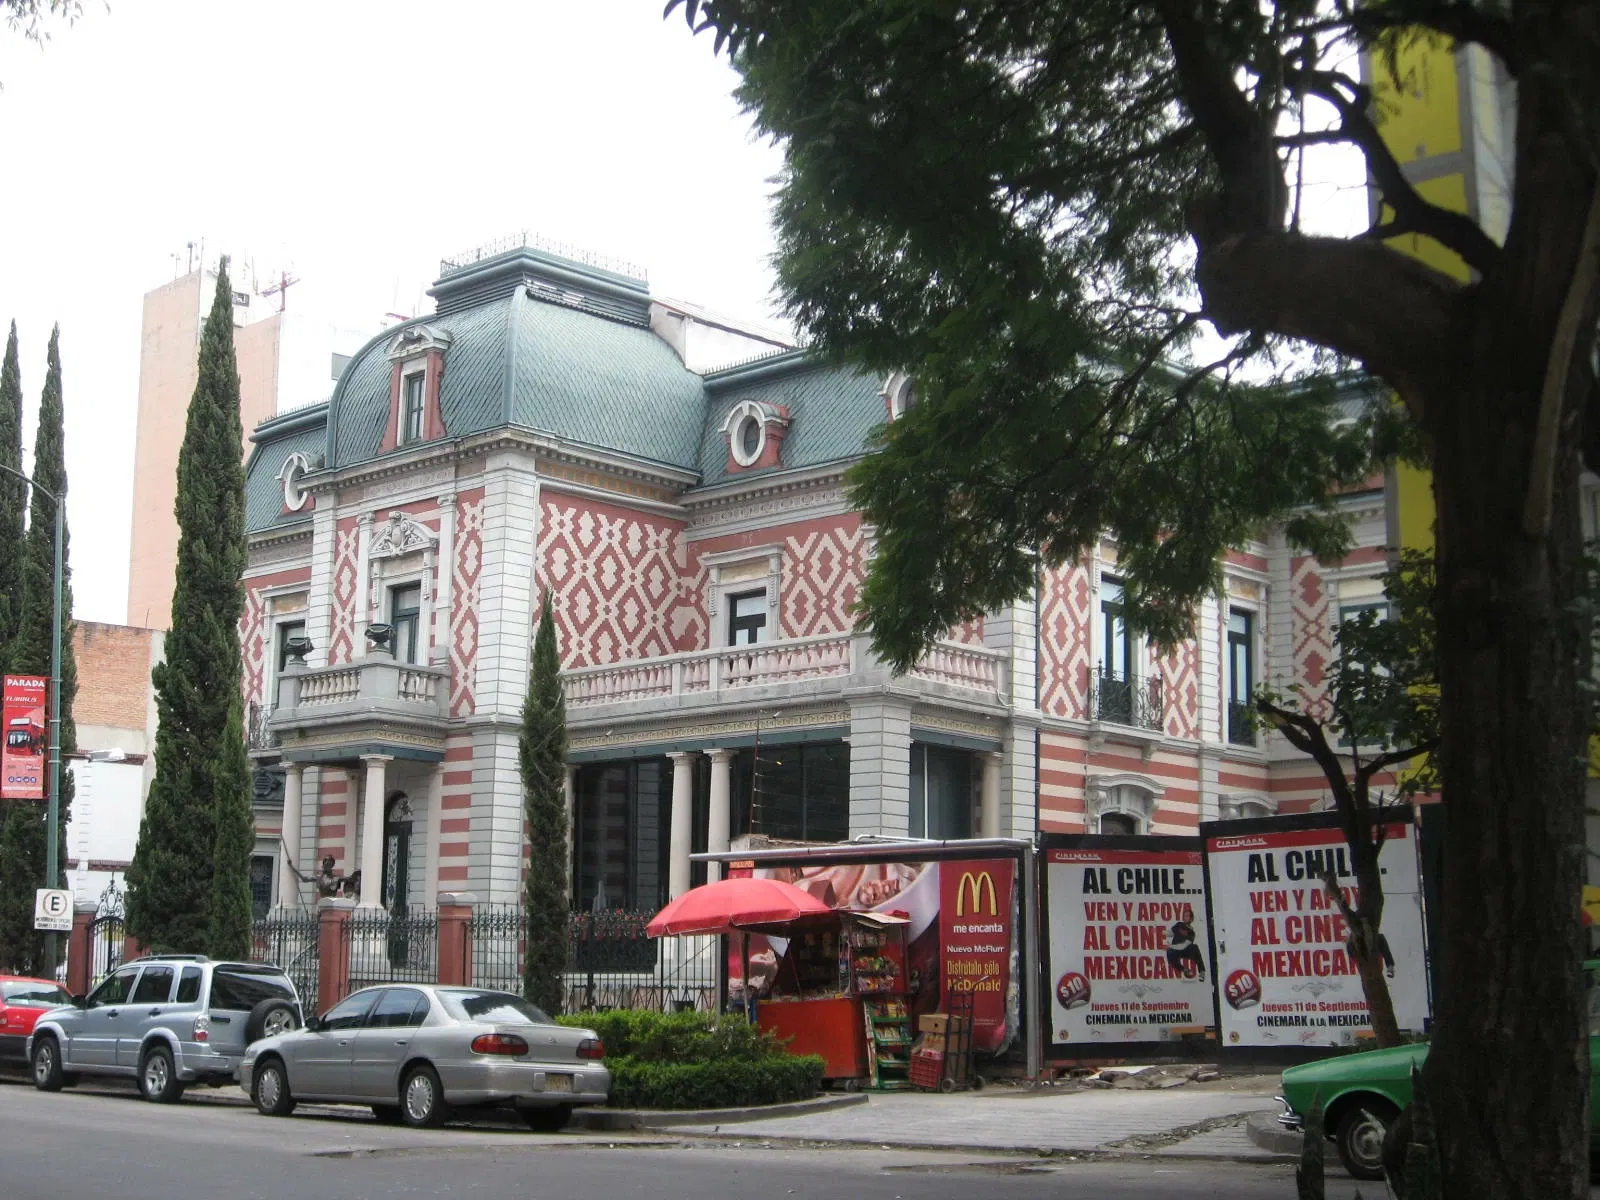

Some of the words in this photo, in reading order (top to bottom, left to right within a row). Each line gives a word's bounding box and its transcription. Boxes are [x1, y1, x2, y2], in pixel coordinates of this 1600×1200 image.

[7, 678, 45, 687] PARADA
[1248, 852, 1279, 883] AL
[1083, 867, 1111, 894] AL
[1118, 867, 1202, 894] CHILE...
[51, 896, 60, 911] E
[1250, 890, 1288, 913] VEN
[1293, 887, 1304, 911] Y
[1084, 902, 1118, 921] VEN
[1122, 902, 1133, 921] Y
[953, 925, 967, 933] me
[969, 924, 1003, 933] encanta
[1251, 917, 1280, 945] AL
[1285, 914, 1347, 944] CINE
[1084, 926, 1110, 950] AL
[1115, 925, 1168, 950] CINE
[947, 945, 972, 953] Nuevo
[1091, 1003, 1119, 1012] Jueves
[1121, 1002, 1129, 1012] 11
[1130, 1002, 1140, 1011] de
[1141, 1001, 1190, 1013] Septiembre
[1262, 1001, 1293, 1013] Jueves
[1296, 1001, 1304, 1012] 11
[1305, 1001, 1317, 1012] de
[1086, 1015, 1132, 1025] CINEMARK
[1149, 1013, 1193, 1024] MEXICANA
[1257, 1016, 1308, 1027] CINEMARK
